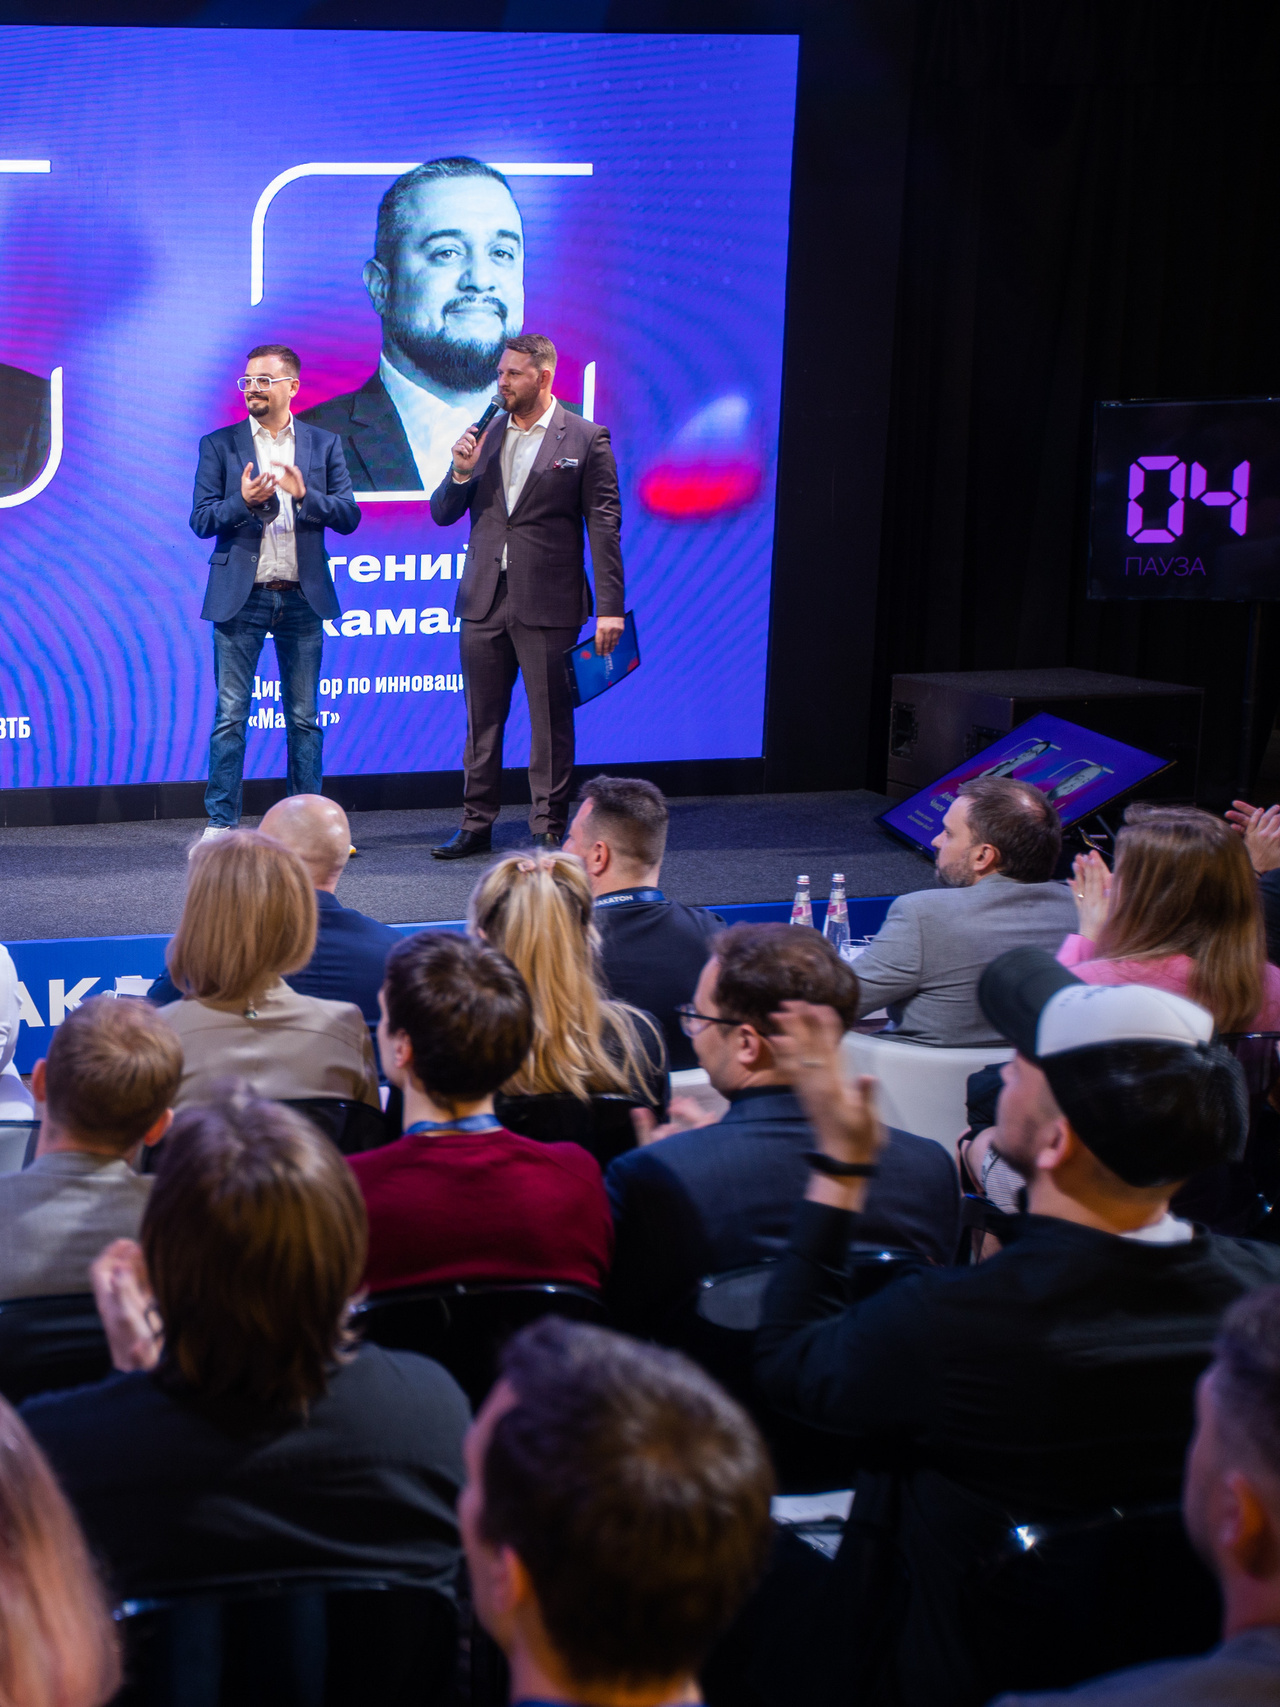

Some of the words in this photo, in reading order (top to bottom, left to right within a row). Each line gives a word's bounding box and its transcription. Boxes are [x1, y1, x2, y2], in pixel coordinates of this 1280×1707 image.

[1127, 455, 1250, 544] 04
[327, 543, 469, 583] гени
[1125, 556, 1206, 576] ПАУЗА
[251, 675, 343, 701] Дирор
[347, 677, 371, 695] по
[248, 707, 341, 730] «Мат»
